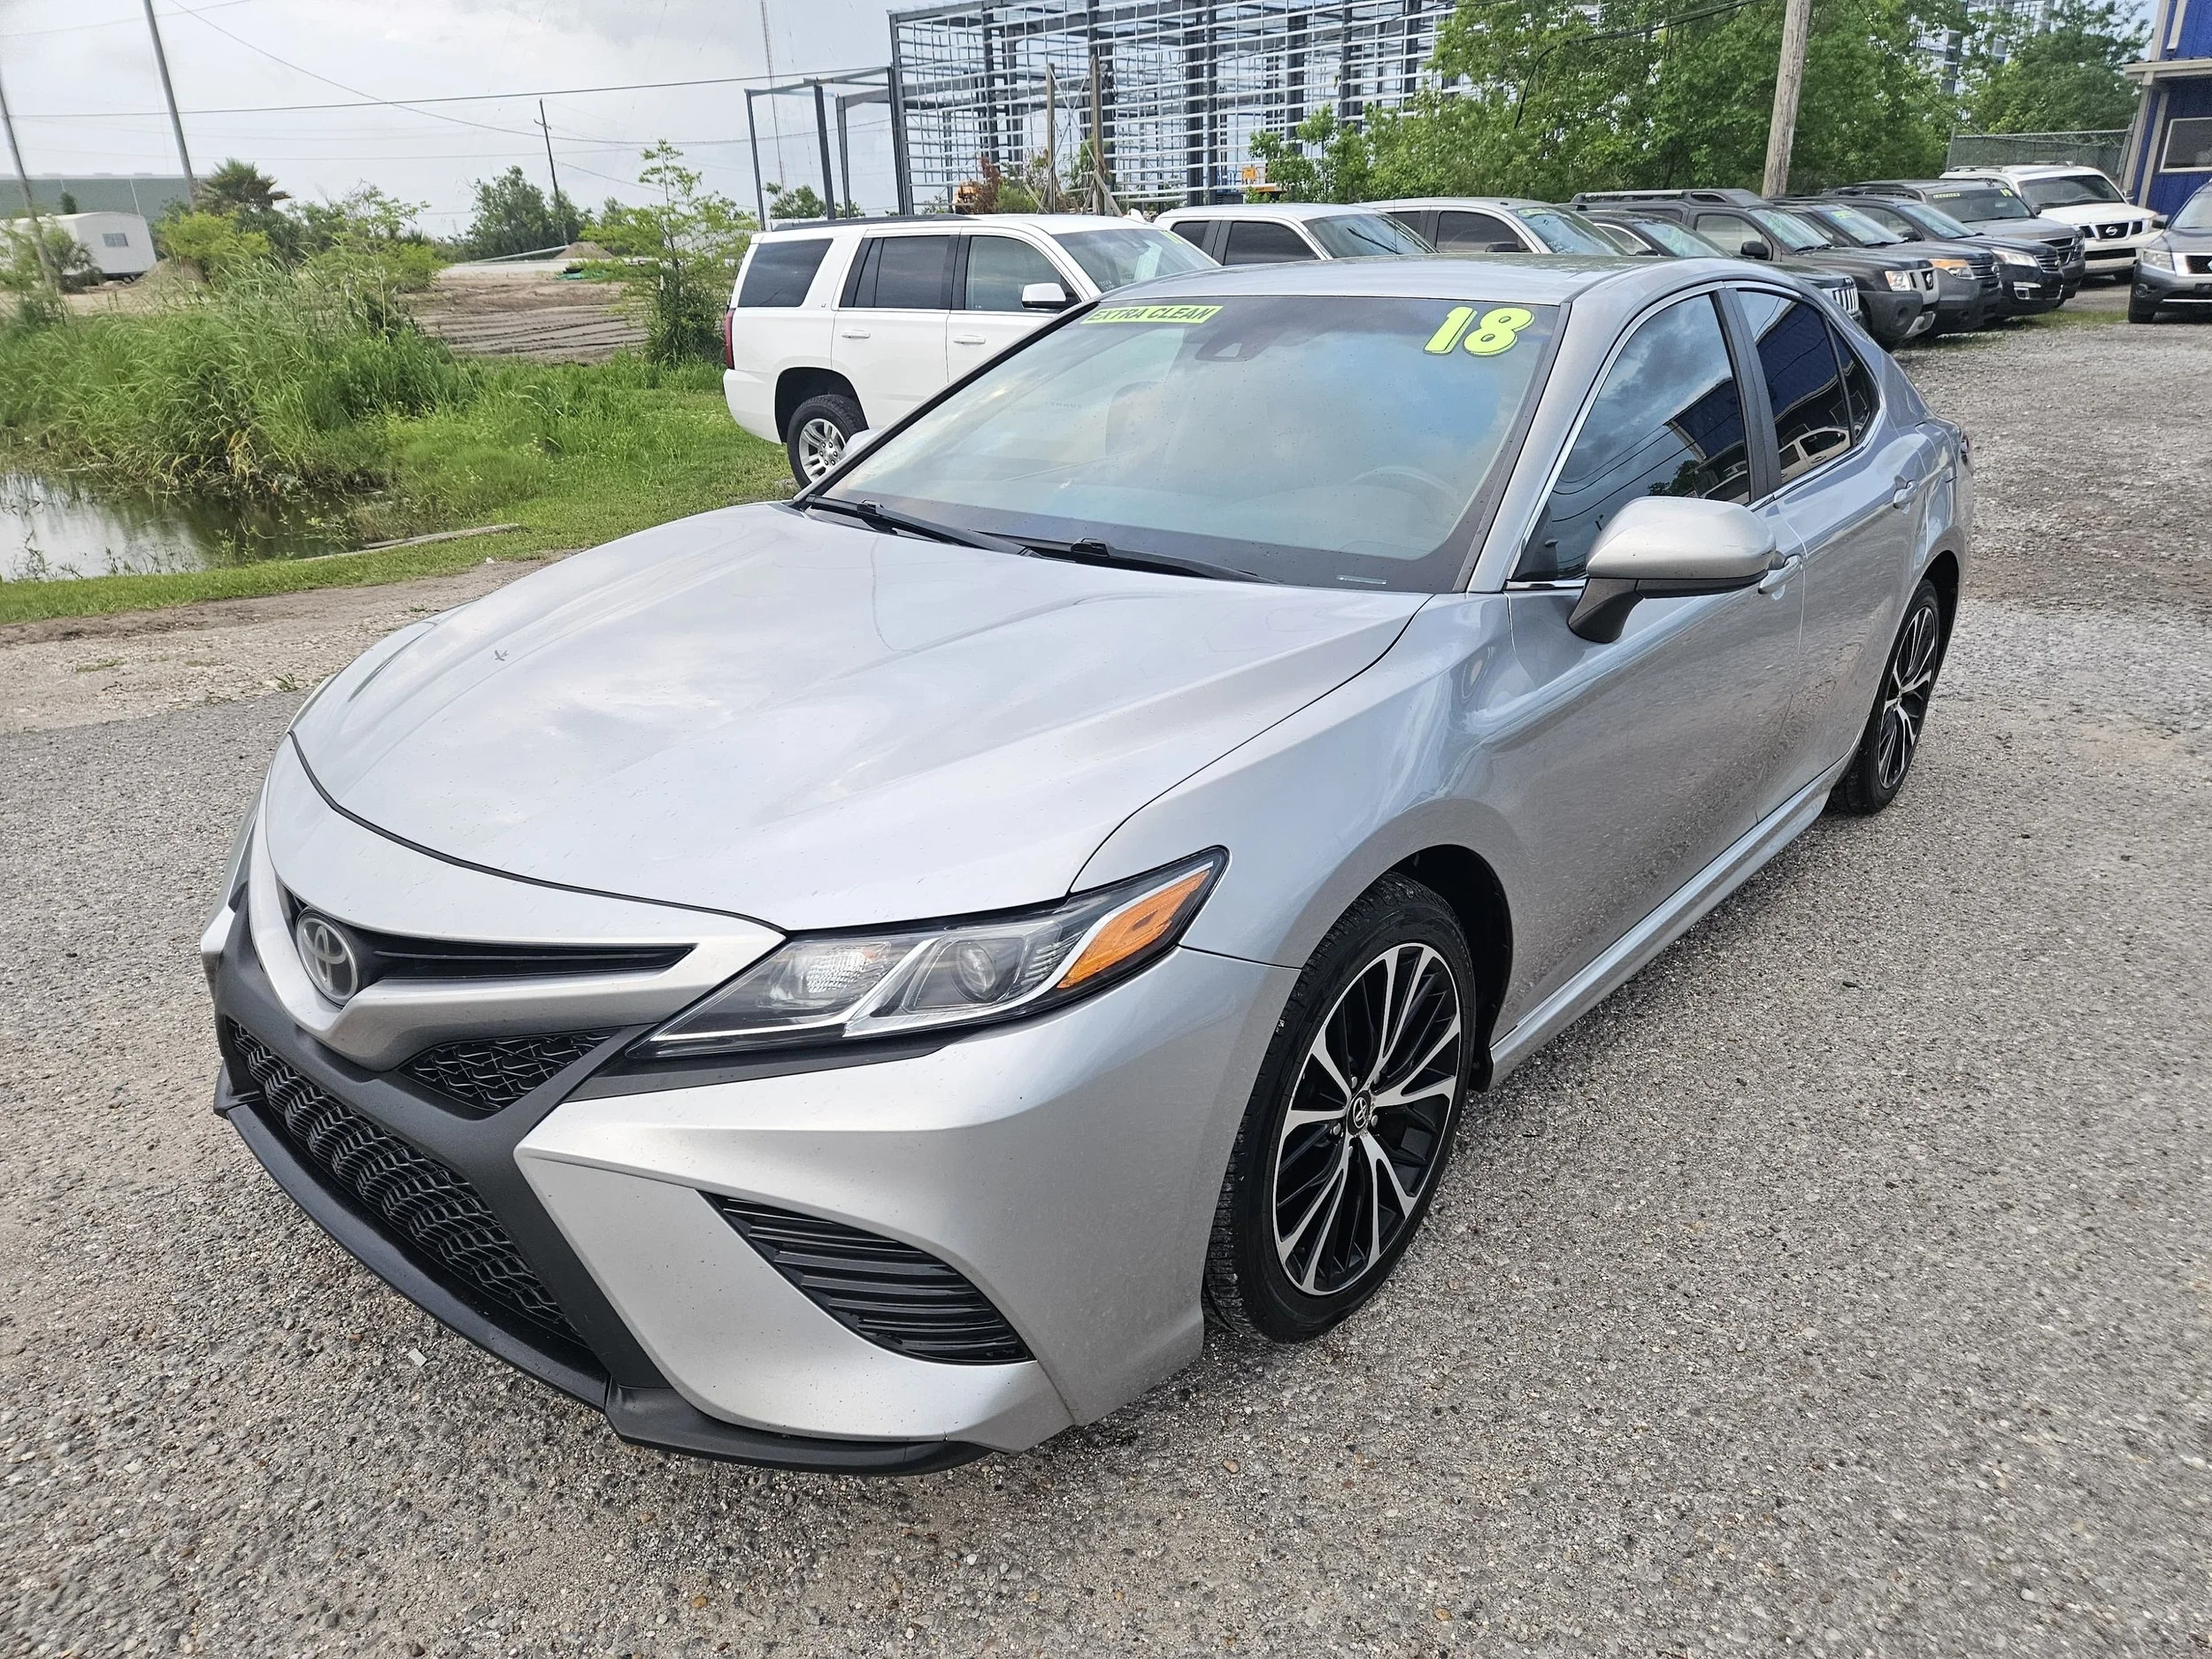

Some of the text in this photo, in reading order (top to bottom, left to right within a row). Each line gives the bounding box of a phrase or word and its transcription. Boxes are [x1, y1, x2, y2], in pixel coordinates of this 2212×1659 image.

[1089, 307, 1216, 320] EXTRA CLEAN
[1423, 306, 1535, 357] 18
